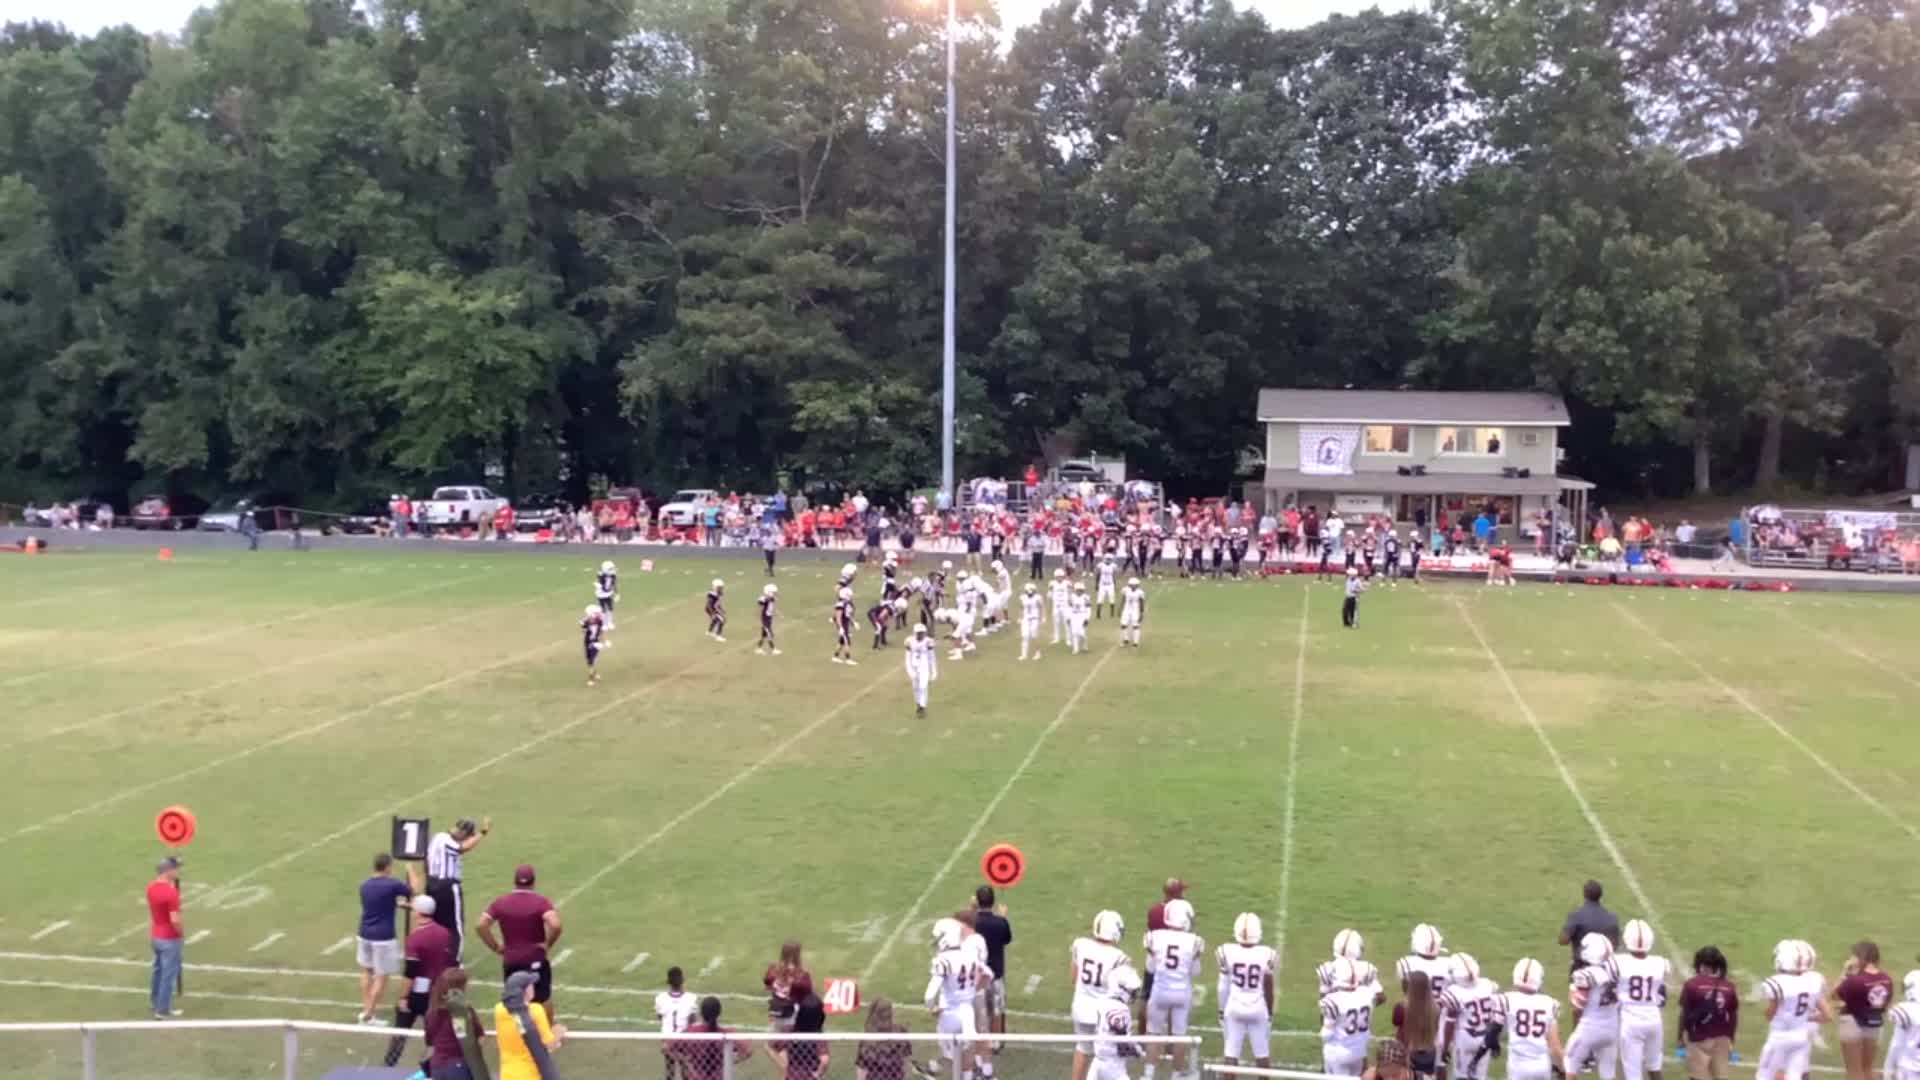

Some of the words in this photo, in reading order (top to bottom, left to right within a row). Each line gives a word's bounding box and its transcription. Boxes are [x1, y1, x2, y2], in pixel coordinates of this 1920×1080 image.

[402, 822, 419, 855] 1
[1166, 944, 1180, 969] 5
[1082, 958, 1103, 988] 51
[823, 979, 856, 1012] 40
[1629, 975, 1653, 1002] 81
[1465, 996, 1492, 1027] 35
[1795, 992, 1809, 1017] 6
[1345, 1006, 1371, 1034] 33
[1515, 1009, 1547, 1038] 85
